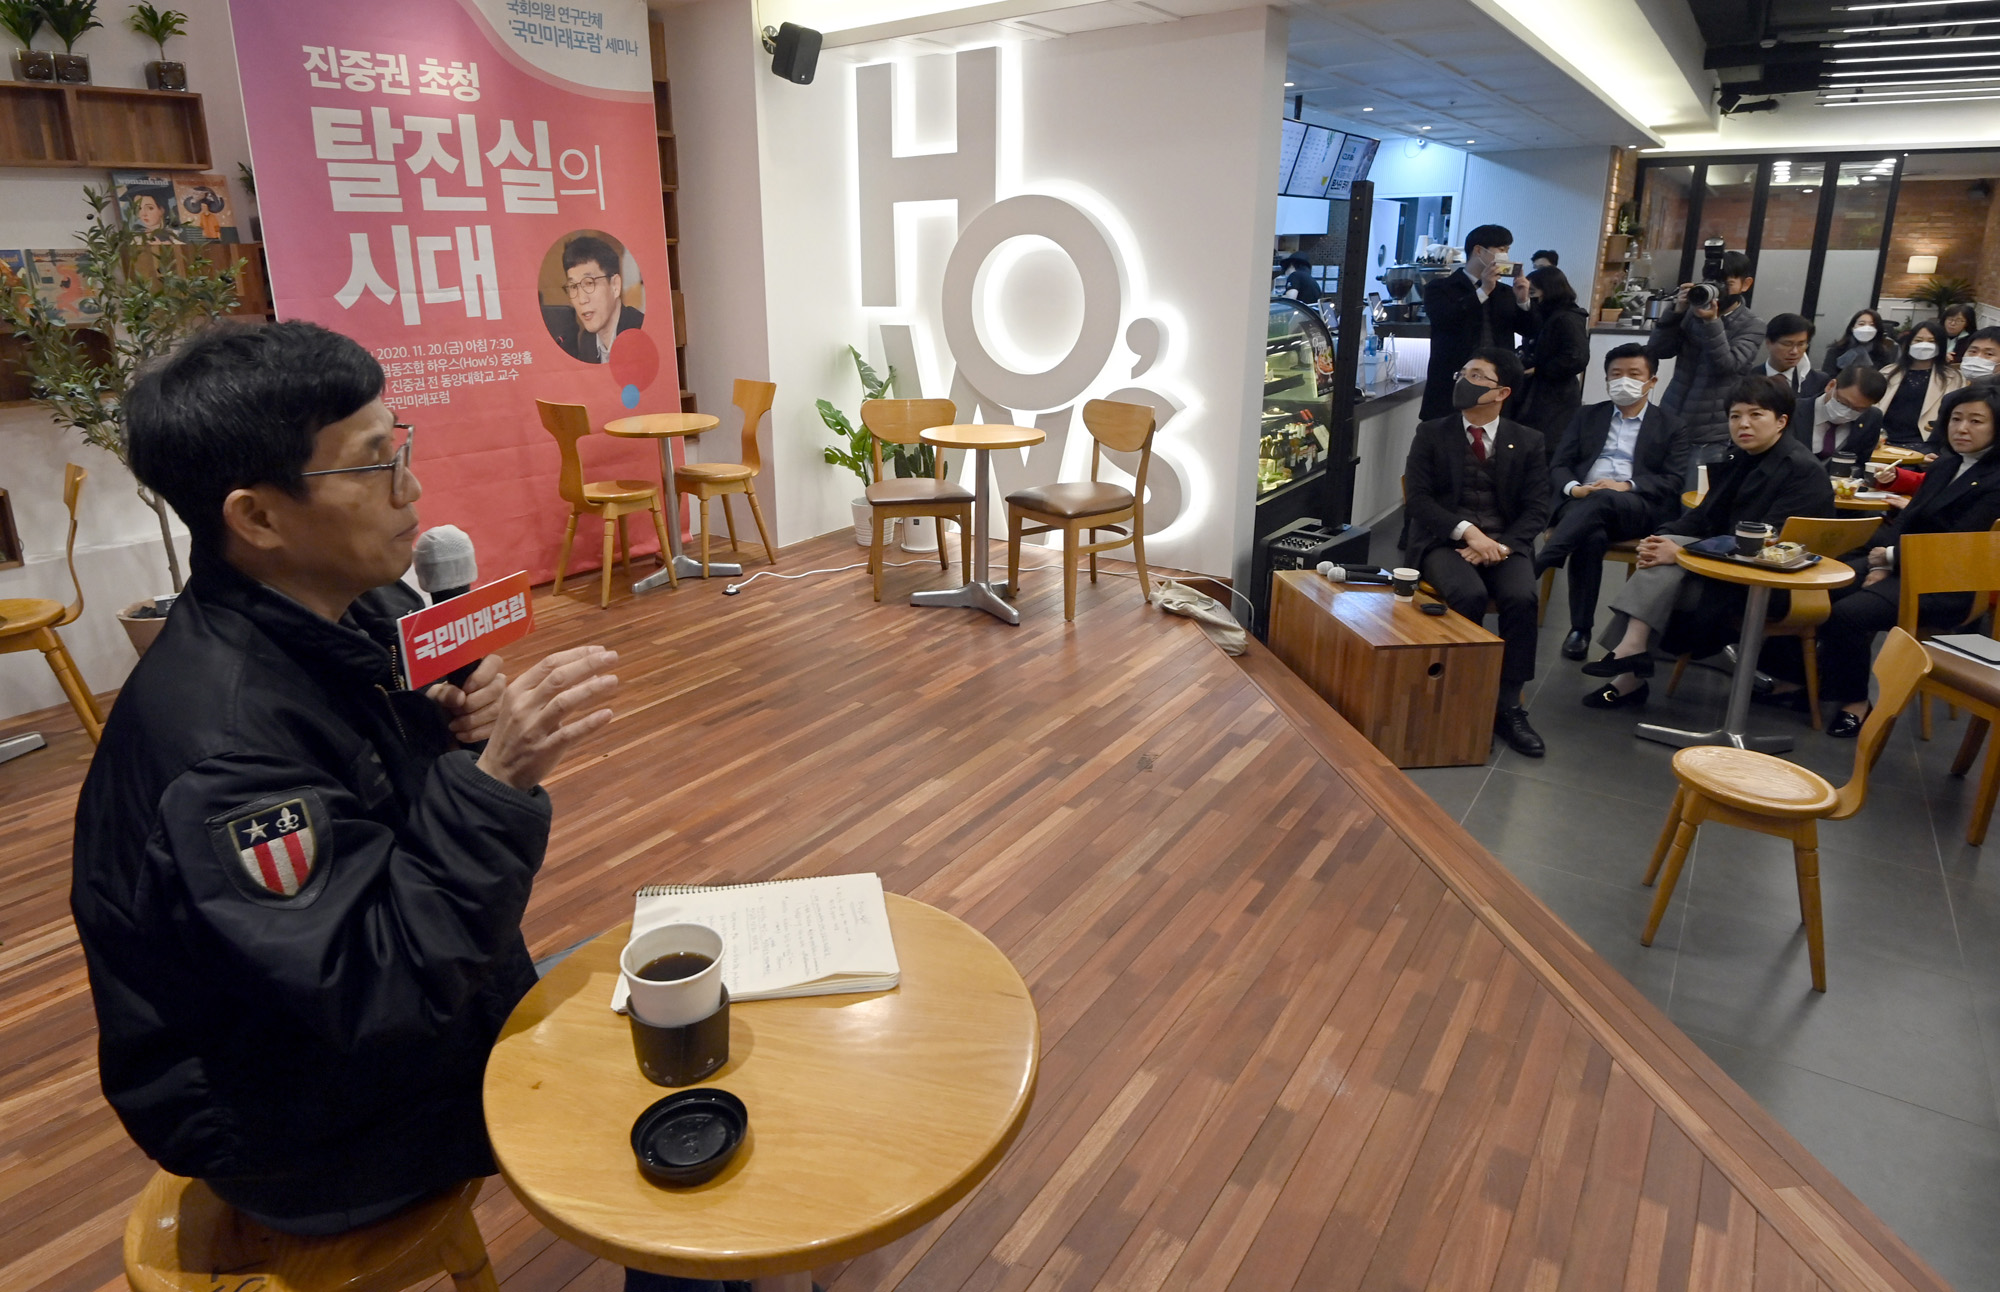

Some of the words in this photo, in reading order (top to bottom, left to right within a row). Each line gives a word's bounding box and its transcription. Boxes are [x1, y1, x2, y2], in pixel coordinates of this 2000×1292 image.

[506, 0, 556, 21] 국회의원
[558, 6, 603, 29] 연구단체
[605, 37, 639, 56] 세미나
[302, 45, 411, 95] 진중권
[418, 57, 481, 102] 초청
[310, 106, 605, 214] 탈진실의
[333, 225, 502, 326] 시대
[376, 346, 411, 360] 2020.
[412, 344, 426, 357] 11.
[465, 339, 488, 353] 아침
[489, 338, 514, 350] 7:30
[427, 355, 498, 373] 하우스(How's)
[500, 351, 533, 366] 중앙홀
[391, 377, 426, 393] 진중권
[427, 375, 439, 389] 전
[440, 371, 496, 388] 동양대학교
[497, 368, 520, 382] 교수
[383, 390, 450, 411] 국민미래포럼
[414, 592, 527, 660] 국민미래포럼
